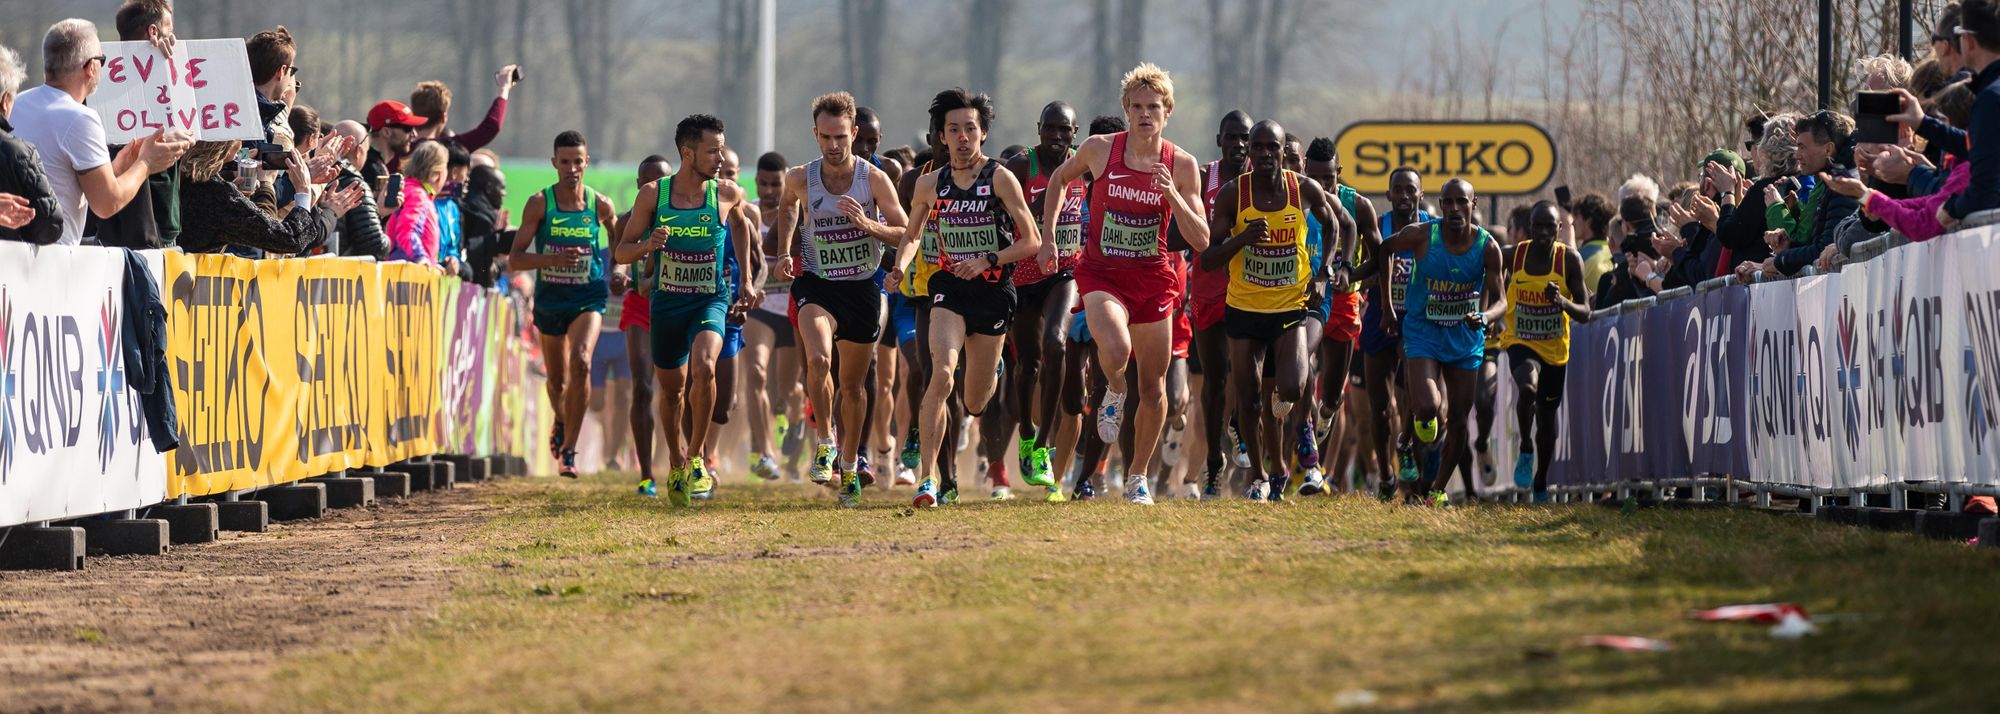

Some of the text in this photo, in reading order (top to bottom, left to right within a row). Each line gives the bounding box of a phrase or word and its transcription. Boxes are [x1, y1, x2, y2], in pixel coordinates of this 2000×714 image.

[108, 54, 208, 89] EVIE
[1354, 139, 1535, 177] SEIKO
[1108, 183, 1163, 206] DANMARK
[942, 200, 988, 213] JAPAN
[815, 217, 833, 228] NEW
[939, 215, 992, 226] Mikkeller
[550, 226, 593, 238] BRASIL
[671, 226, 712, 237] RASIL
[941, 230, 995, 249] KOMATSU
[1103, 226, 1157, 247] DAHL-JESSEN
[662, 251, 715, 261] Mikkeller
[820, 243, 871, 265] BAXTER
[1103, 247, 1136, 258] AARHUS
[661, 264, 713, 282] A. RAMOS
[822, 268, 855, 278] AARHUS
[1245, 257, 1295, 276] KIPLIMO
[1244, 276, 1276, 287] AARHUS
[1516, 288, 1545, 304] UGAN
[1517, 317, 1561, 332] ROTICH
[172, 271, 270, 476] SEIKO
[294, 274, 373, 464] SEIKO
[21, 311, 84, 455] QNB
